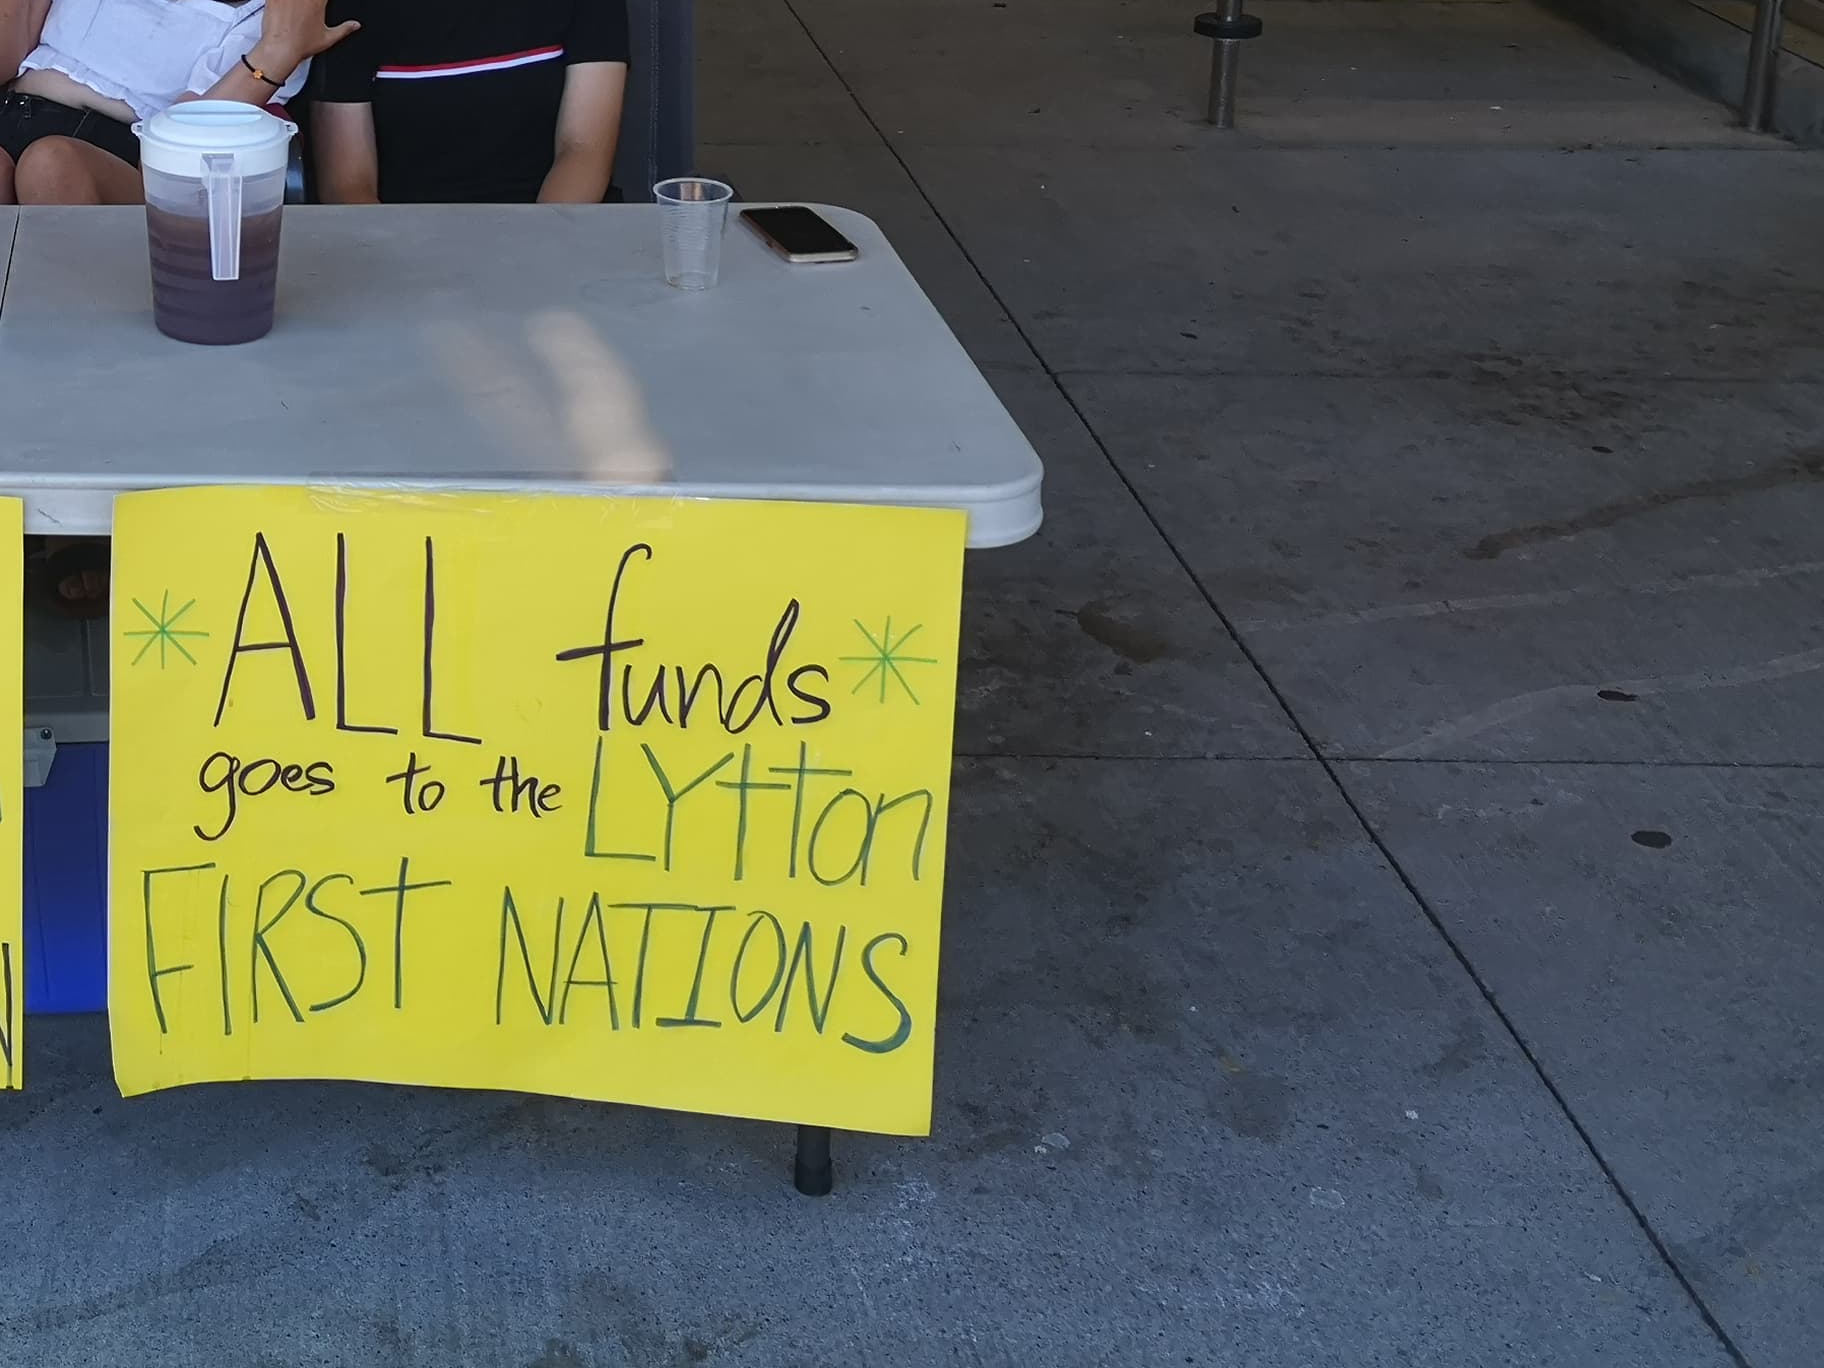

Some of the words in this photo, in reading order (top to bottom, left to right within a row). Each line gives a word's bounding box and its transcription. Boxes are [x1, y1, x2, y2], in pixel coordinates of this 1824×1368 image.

[213, 530, 483, 745] ALL
[555, 542, 833, 734] funds
[192, 748, 336, 843] goes
[386, 751, 446, 816] to
[479, 754, 565, 815] the
[495, 885, 915, 1055] NATIONS
